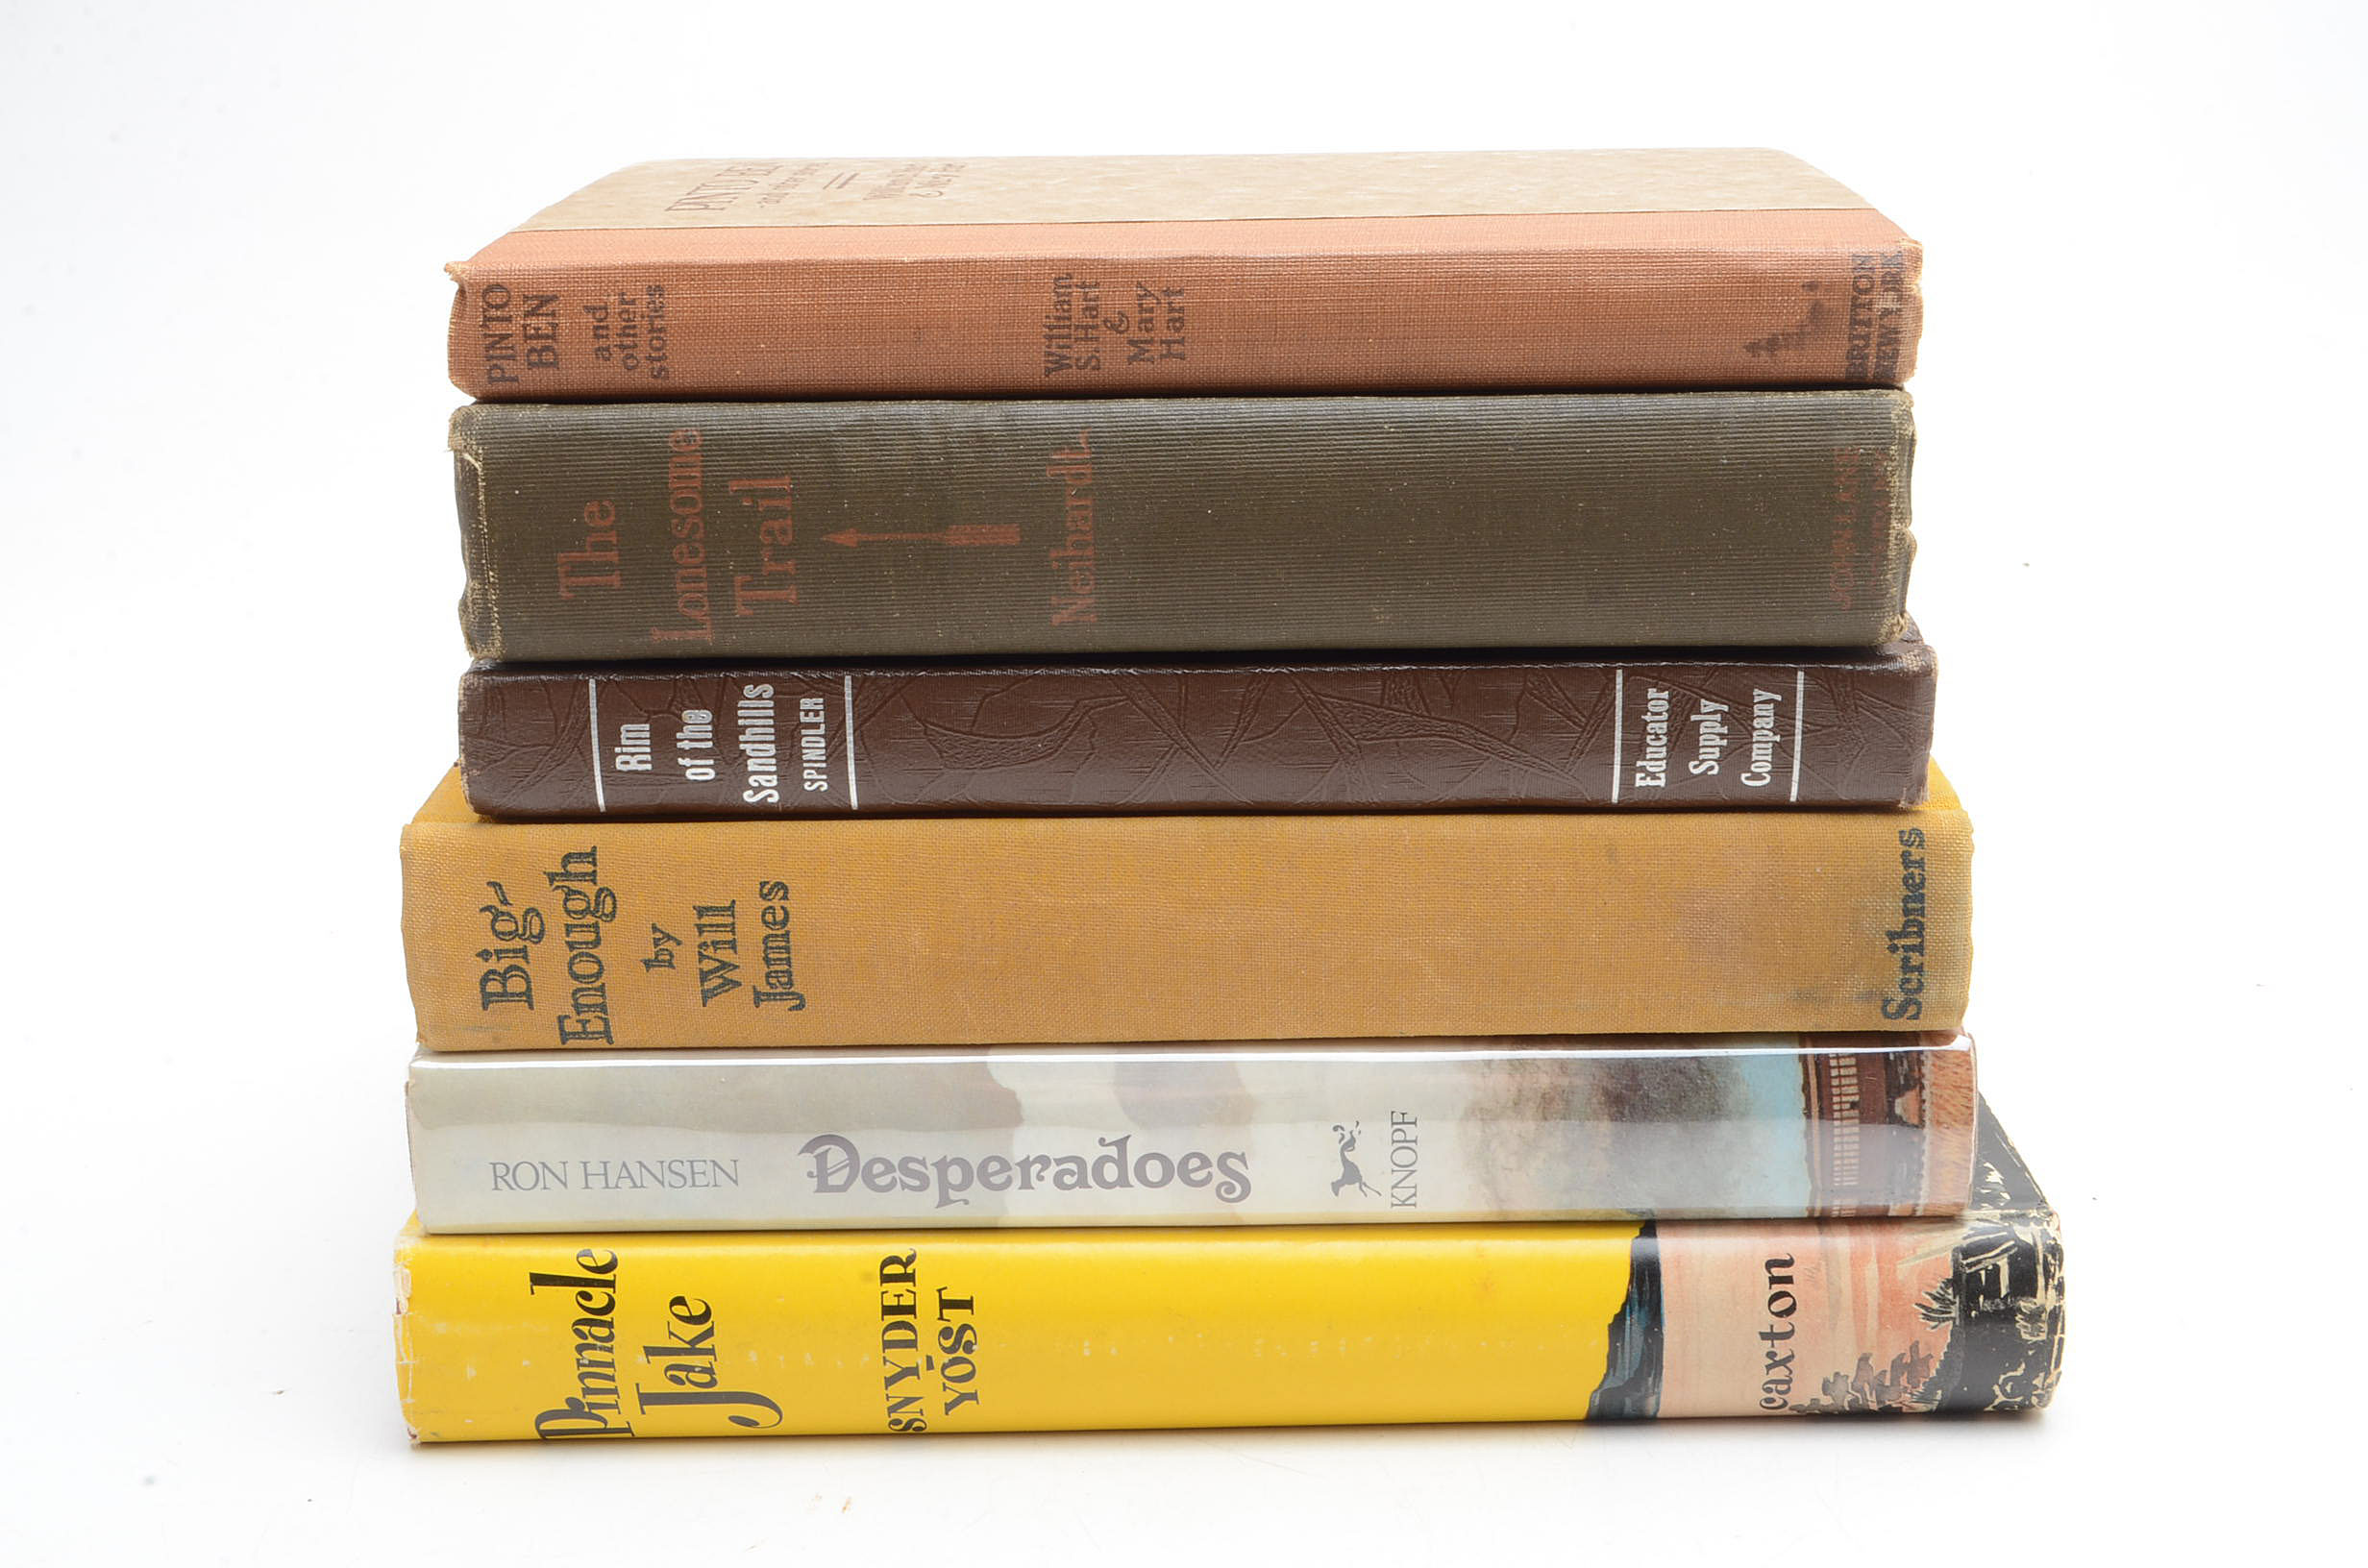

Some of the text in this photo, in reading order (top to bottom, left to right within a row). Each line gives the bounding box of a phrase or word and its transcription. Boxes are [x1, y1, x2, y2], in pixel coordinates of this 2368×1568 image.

[481, 284, 520, 383] PINTO
[522, 294, 559, 369] BEN
[583, 304, 612, 361] and
[613, 292, 639, 370] other
[641, 285, 669, 379] stories
[1043, 273, 1073, 377] William
[1101, 310, 1130, 333] &
[1127, 282, 1161, 365] Mary
[1159, 287, 1186, 360] Hart
[557, 500, 622, 600] The
[650, 429, 715, 645] Lonesome
[728, 477, 800, 616] Trail
[614, 723, 653, 772] Rim
[676, 709, 716, 781] of the
[737, 683, 780, 803] Sandhills
[799, 697, 828, 792] SPINDLER
[1635, 687, 1669, 788] Educator
[1688, 698, 1729, 775] Supply
[1740, 688, 1782, 787] Company
[543, 845, 618, 1045] Enough
[641, 922, 683, 973] by
[693, 898, 742, 1007] Will
[752, 880, 806, 1012] James
[1881, 827, 1927, 1020] Scribners
[488, 1133, 1253, 1210] RON HANSEN Desperadoes
[1390, 1110, 1419, 1211] KNOPF
[529, 1247, 637, 1440] Pinnacle
[633, 1292, 784, 1430] Jake
[878, 1247, 928, 1433] SNYDER
[935, 1286, 981, 1416] YOST
